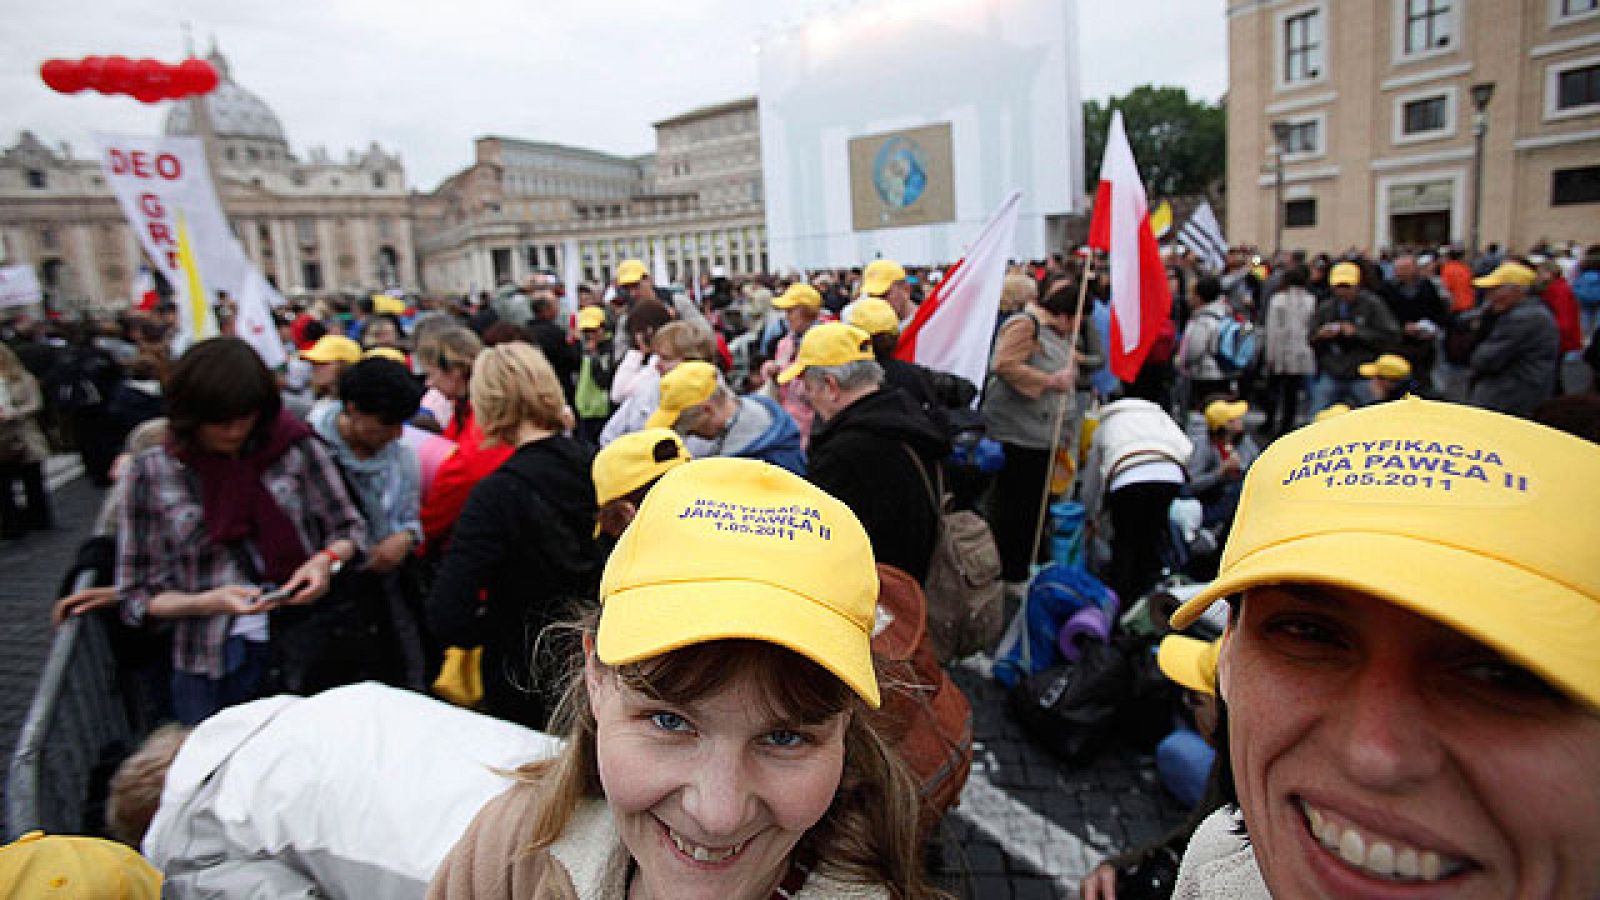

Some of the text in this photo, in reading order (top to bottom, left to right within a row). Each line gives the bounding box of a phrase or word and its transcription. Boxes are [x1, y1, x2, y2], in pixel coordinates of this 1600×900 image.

[109, 148, 181, 180] DEO
[1302, 440, 1502, 466] BEATYFIKACJA
[1282, 455, 1528, 491] JANA PAWŁA II
[1325, 473, 1452, 491] 1.05.2011
[679, 507, 735, 520] JANA
[716, 521, 795, 541] 1.05.2011
